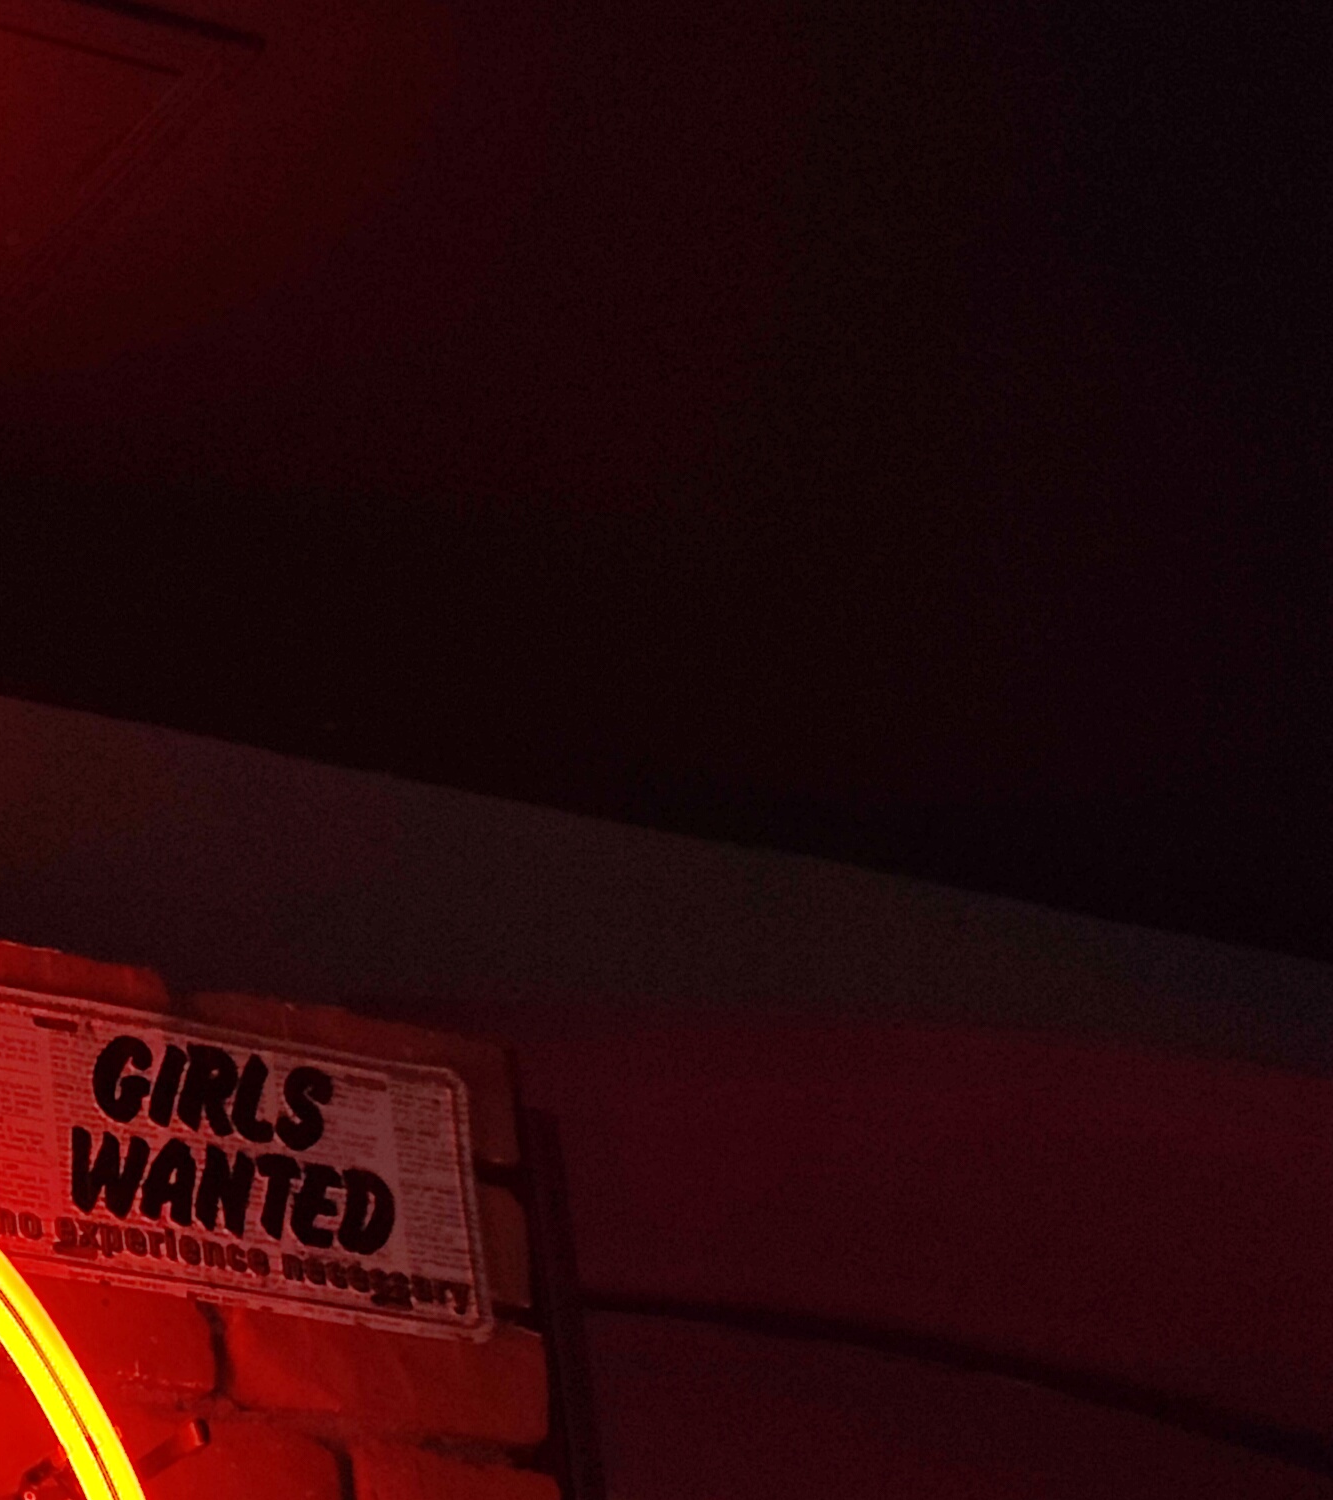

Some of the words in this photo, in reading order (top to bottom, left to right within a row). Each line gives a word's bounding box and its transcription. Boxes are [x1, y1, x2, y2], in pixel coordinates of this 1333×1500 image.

[92, 1035, 333, 1151] GIRLS
[55, 1216, 271, 1276] experience
[71, 1125, 396, 1256] WANTED
